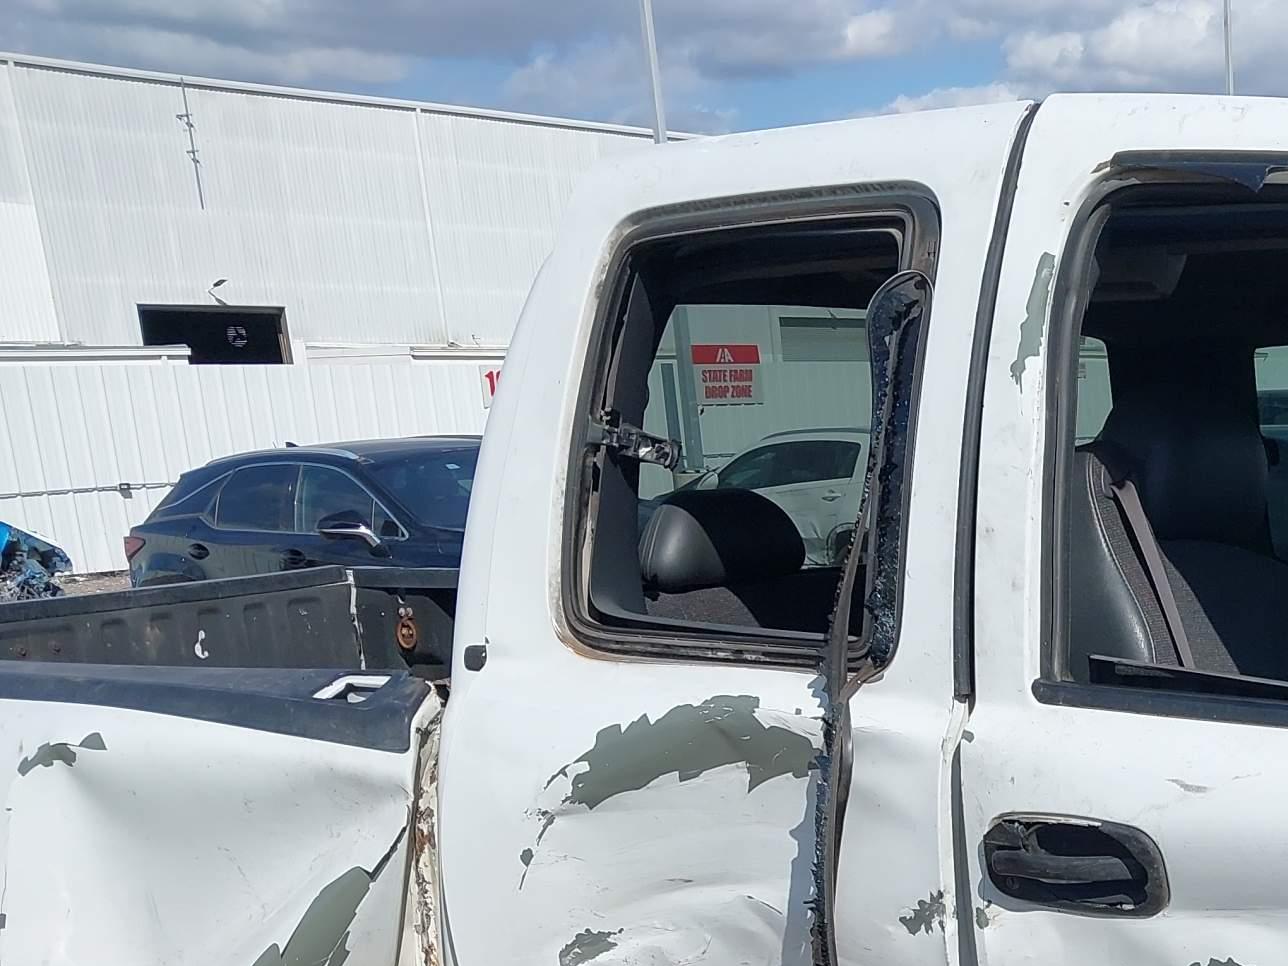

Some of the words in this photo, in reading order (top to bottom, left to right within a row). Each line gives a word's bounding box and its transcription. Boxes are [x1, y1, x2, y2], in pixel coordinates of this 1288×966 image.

[484, 370, 501, 397] 1
[701, 369, 728, 383] STATE
[729, 369, 753, 383] FARM
[704, 385, 729, 399] DROP
[730, 384, 752, 399] ZONE
